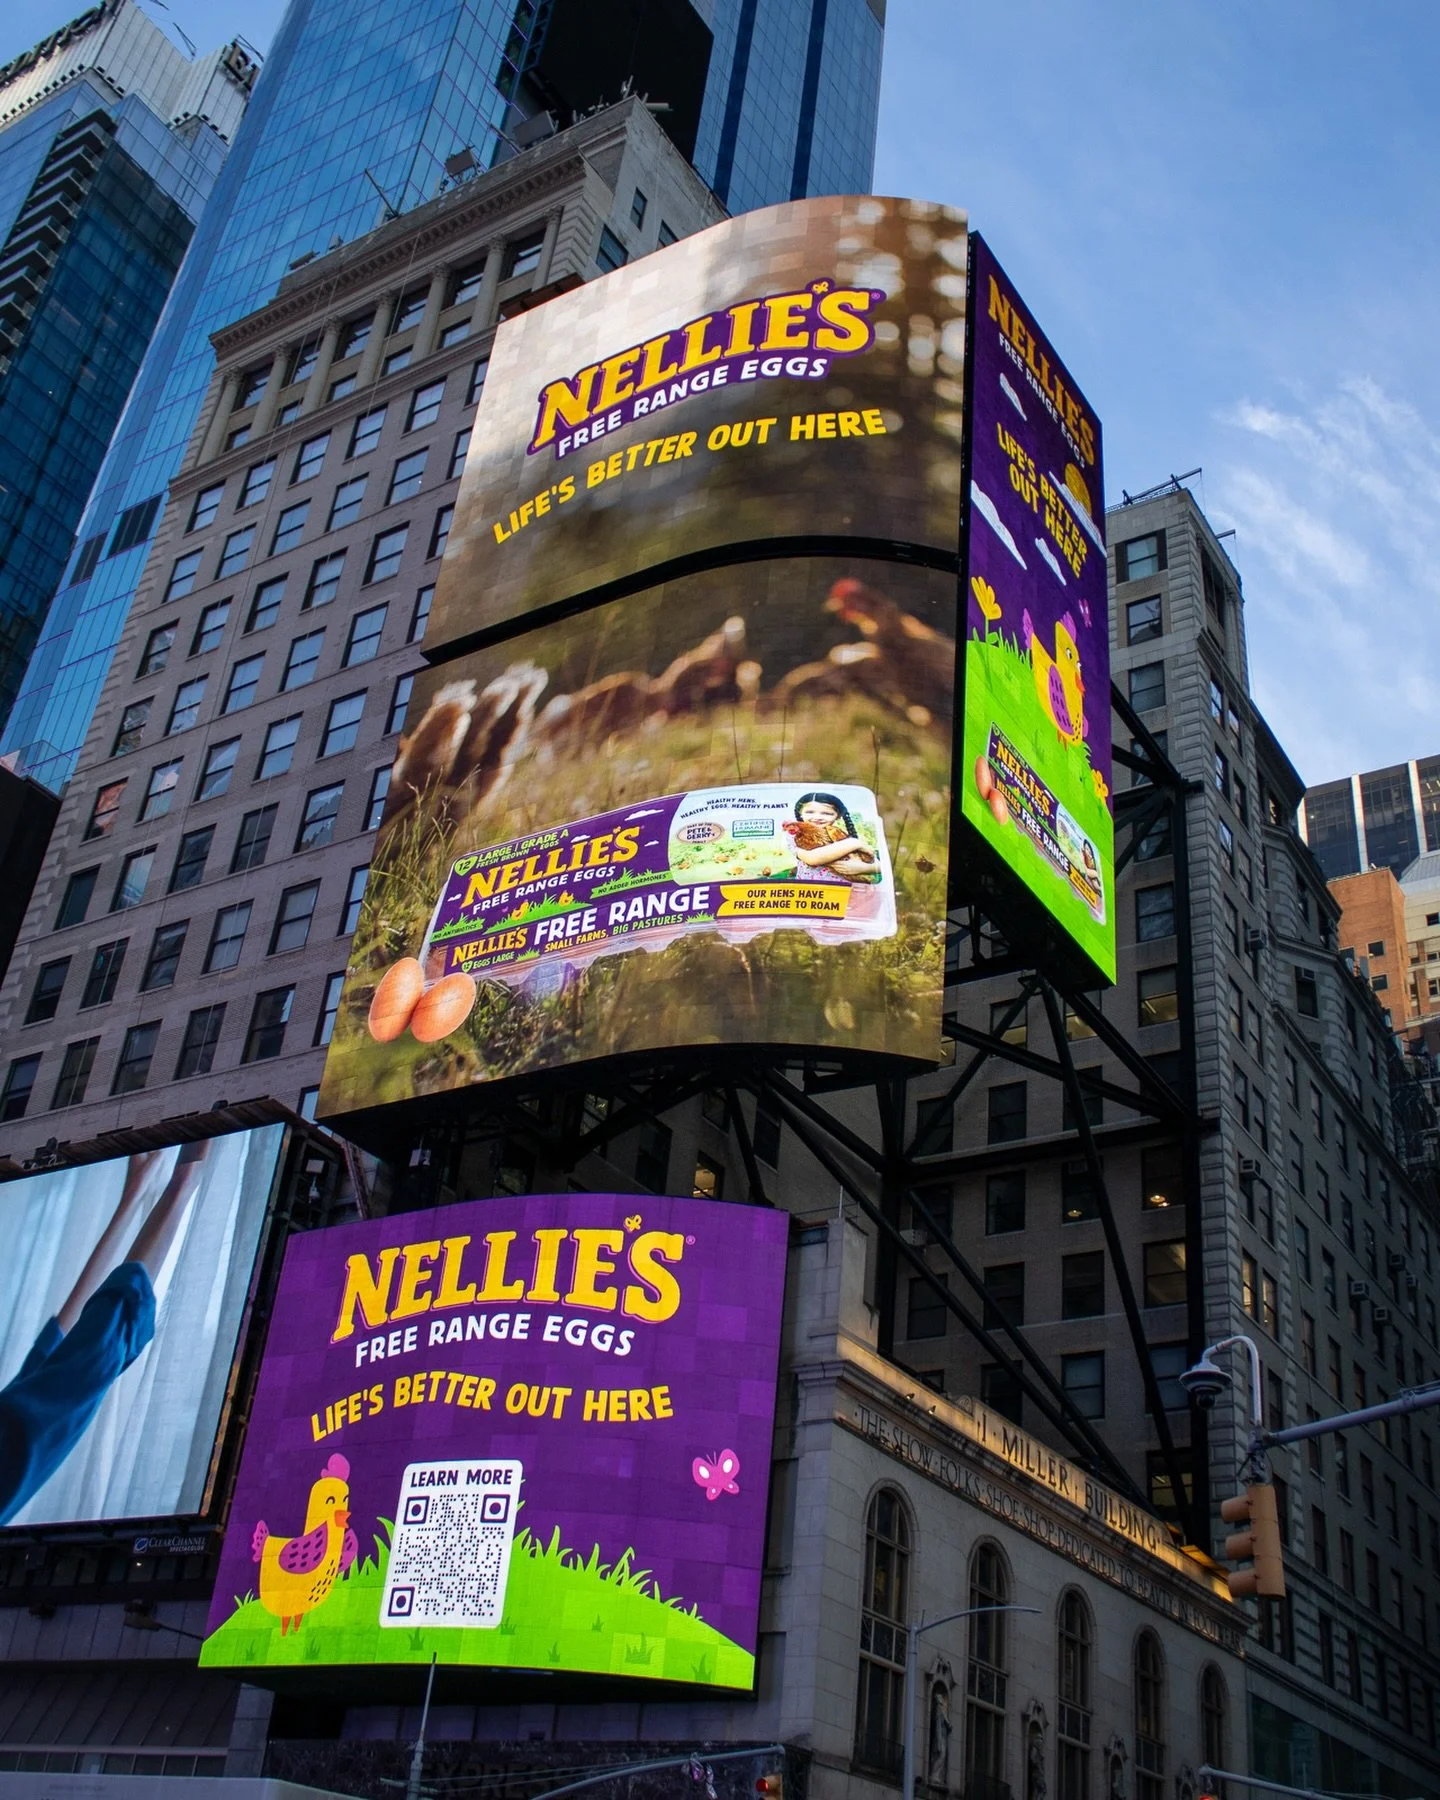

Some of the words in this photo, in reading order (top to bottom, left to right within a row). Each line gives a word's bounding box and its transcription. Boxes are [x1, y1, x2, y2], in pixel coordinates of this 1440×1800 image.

[558, 408, 622, 458] FREE
[633, 369, 728, 419] RANGE
[740, 357, 827, 380] EGGS
[999, 331, 1024, 373] FREE
[1026, 368, 1058, 424] RANGE
[1061, 421, 1085, 469] EGGS
[493, 475, 576, 544] LIFE'S
[586, 430, 698, 489] BETTER
[706, 417, 777, 451] OUT
[789, 408, 887, 441] HERE
[997, 422, 1037, 484] LIFE'S
[1040, 472, 1088, 563] BETTER
[1009, 462, 1040, 514] OUT
[1045, 504, 1082, 579] HERE
[680, 806, 709, 819] HEALTHY
[1022, 807, 1041, 838] FREE
[1043, 832, 1069, 872] RANGE
[459, 861, 471, 871] 12
[478, 845, 513, 862] LARGE
[521, 832, 558, 850] GRADE
[560, 829, 569, 838] A
[473, 892, 510, 915] FREE
[515, 874, 569, 899] RANGE
[573, 866, 616, 883] EGGS
[534, 908, 598, 946] FREE
[608, 886, 710, 926] RANGE
[733, 901, 755, 909] FREE
[759, 901, 791, 909] RANGE
[795, 901, 807, 909] TO
[811, 901, 840, 911] ROAM
[747, 889, 766, 898] OUR
[770, 889, 795, 898] HENS
[798, 890, 824, 899] HAVE
[451, 927, 529, 967] NELLIE'S
[473, 957, 491, 970] EGGS
[492, 951, 515, 962] LARGE
[544, 938, 573, 953] SMALL
[612, 923, 629, 936] BIG
[632, 914, 684, 931] PASTURES
[355, 1329, 418, 1368] FREE
[428, 1313, 531, 1345] RANGE
[542, 1315, 636, 1356] EGGS
[311, 1384, 384, 1443] LIFE'S
[393, 1371, 497, 1411] BETTER
[505, 1383, 572, 1419] OUT
[583, 1385, 674, 1422] HERE
[410, 1469, 459, 1488] LEARN
[466, 1469, 513, 1485] MORE
[858, 1403, 888, 1437] THE
[892, 1426, 934, 1469] SHOW
[939, 1454, 981, 1499] FOLKS
[986, 1483, 1019, 1521] SHOE
[1023, 1506, 1055, 1541] SHOP
[1058, 1526, 1116, 1578] DEDICATED
[1119, 1563, 1134, 1589] TO
[1002, 1425, 1070, 1496] MILLER
[1084, 1480, 1157, 1550] BUILDING
